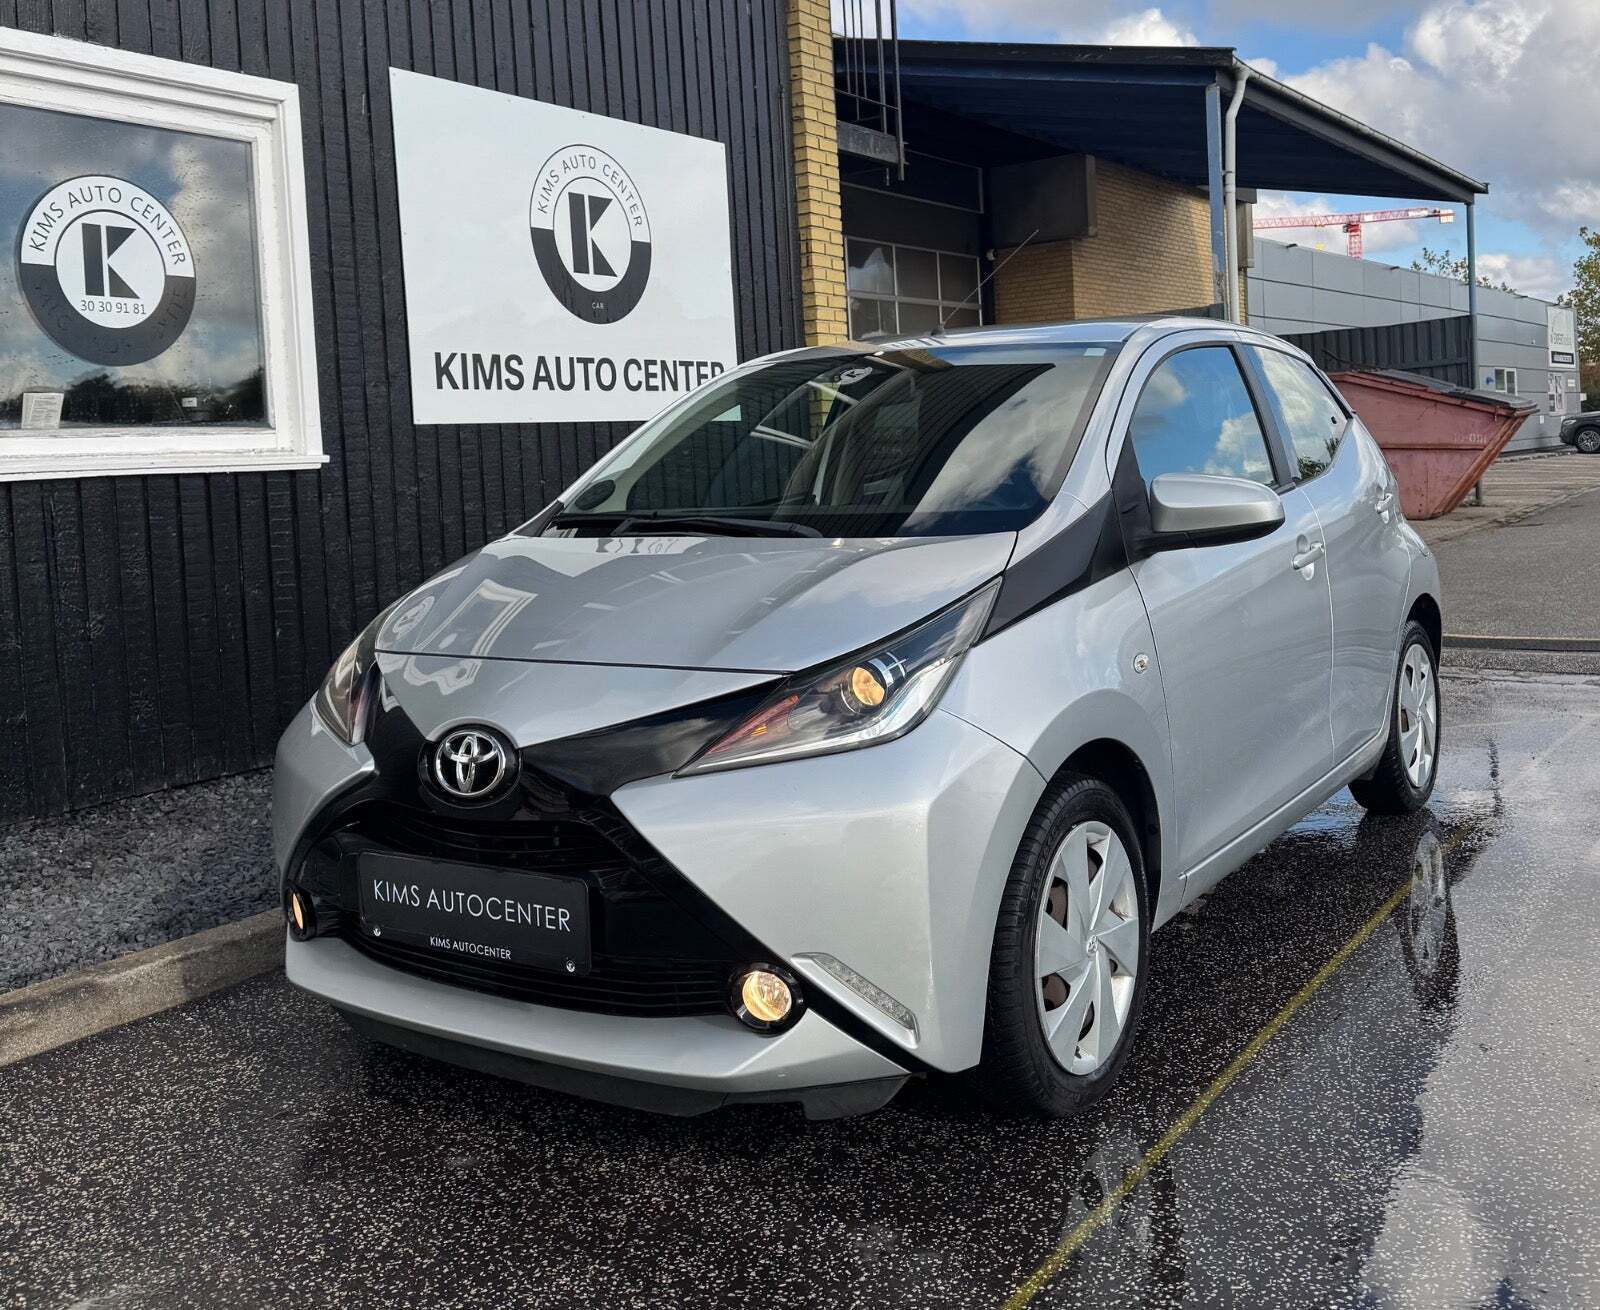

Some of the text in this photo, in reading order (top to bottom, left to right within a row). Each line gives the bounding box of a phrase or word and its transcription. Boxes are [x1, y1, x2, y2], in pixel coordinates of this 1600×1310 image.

[537, 154, 642, 227] KIMS AUTO CENTER
[29, 185, 186, 265] KIMS AUTO CENTER
[81, 300, 146, 315] 30 30 91 81
[434, 351, 525, 391] KIMS
[532, 355, 618, 391] AUTO
[373, 879, 571, 932] KIMS AUTOCENTER
[429, 935, 511, 960] KIMS AUTOCENTER
